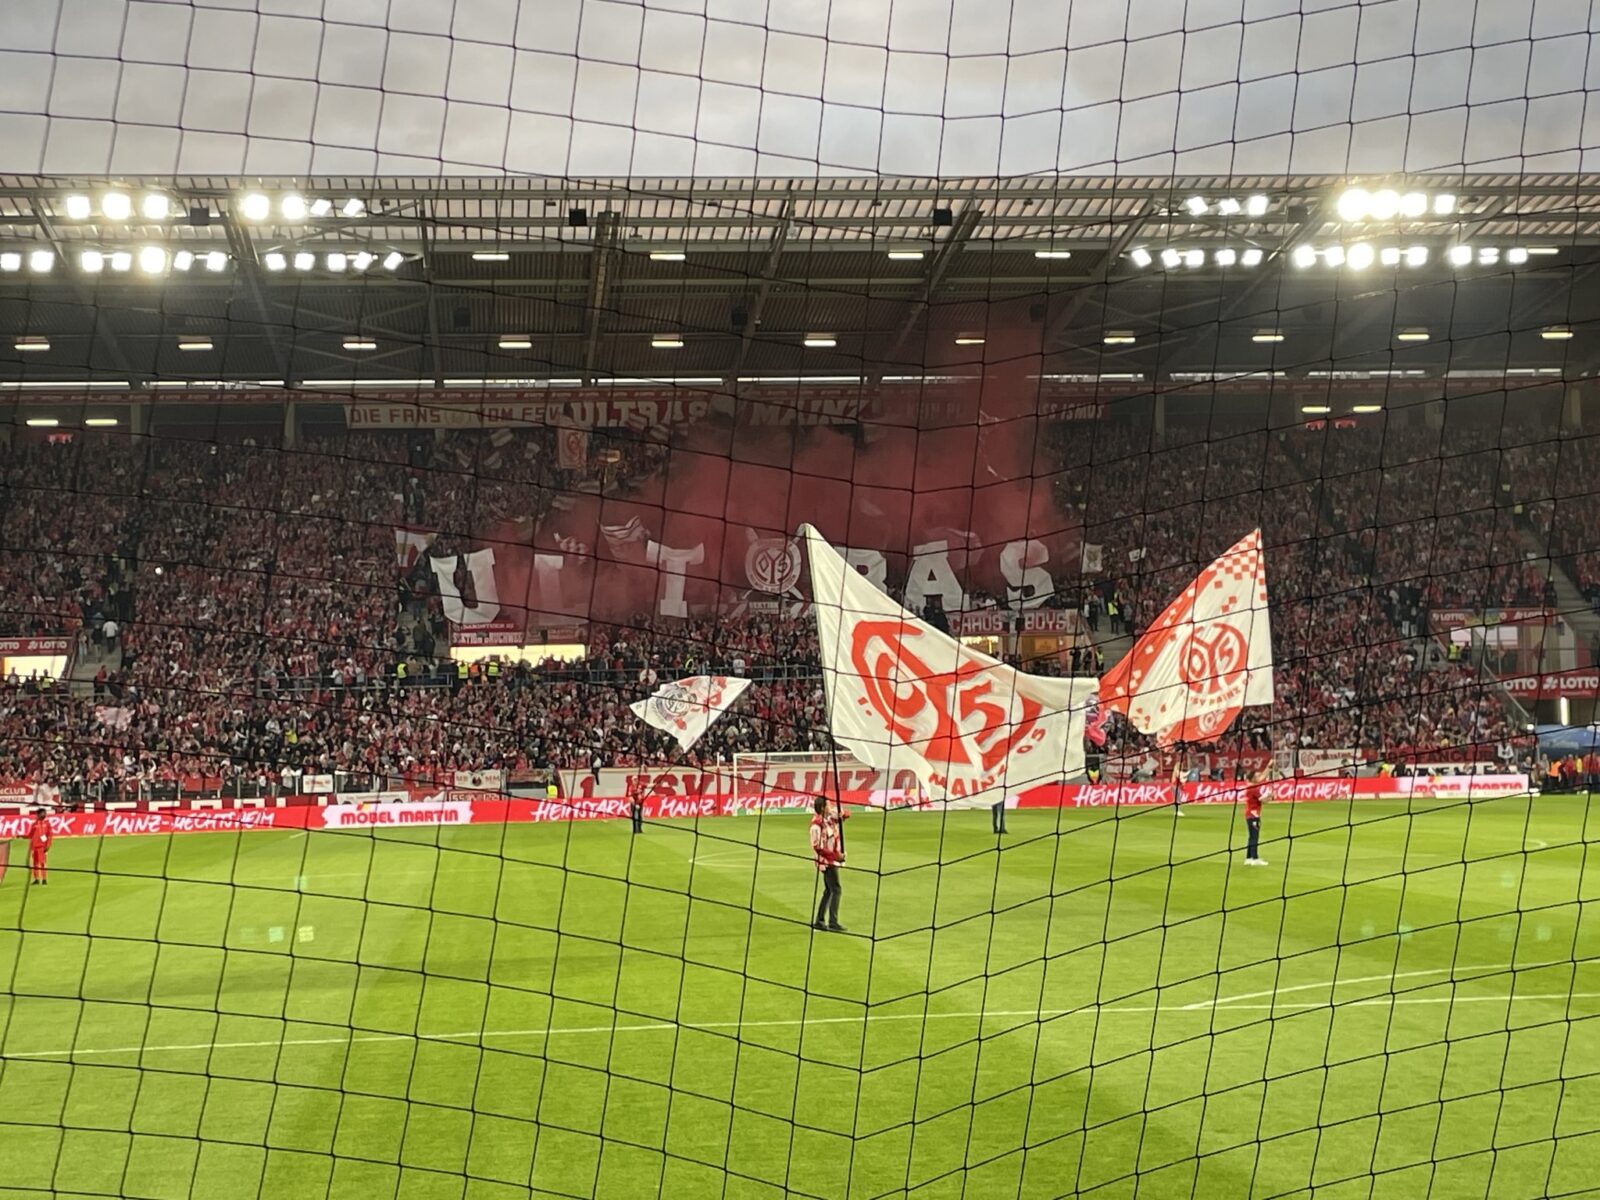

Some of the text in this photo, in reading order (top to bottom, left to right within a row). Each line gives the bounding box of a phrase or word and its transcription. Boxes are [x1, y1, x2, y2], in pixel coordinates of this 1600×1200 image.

[350, 407, 380, 424] DIE
[390, 407, 441, 424] FANS
[39, 641, 67, 650] LOTTO
[1560, 676, 1600, 691] LOTTO
[399, 808, 459, 824] MARTIN
